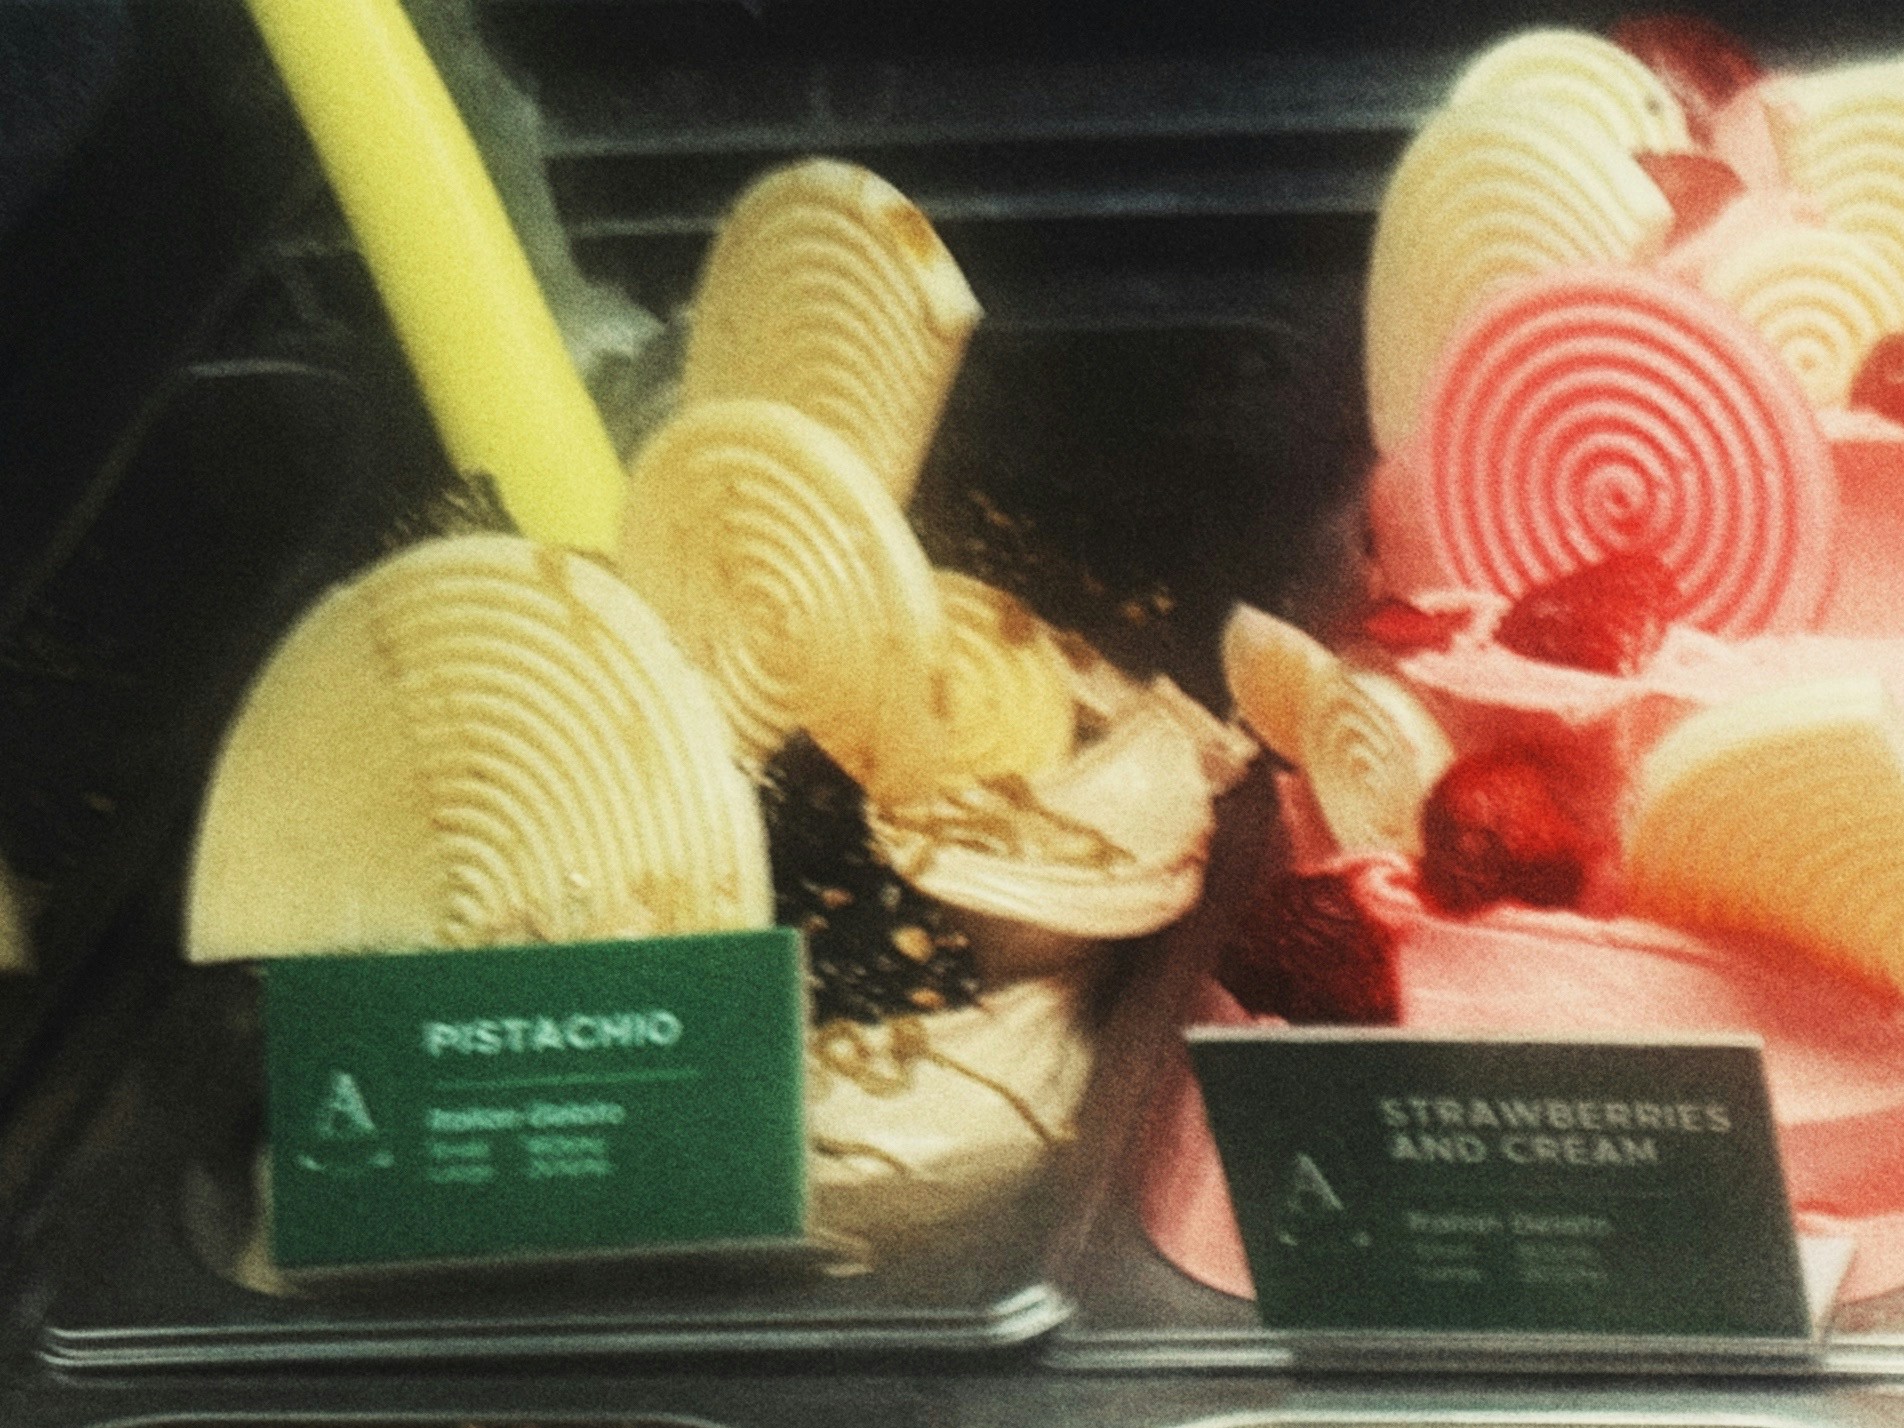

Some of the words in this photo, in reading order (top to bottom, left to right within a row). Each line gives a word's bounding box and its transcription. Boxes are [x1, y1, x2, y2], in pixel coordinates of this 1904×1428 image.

[422, 1009, 683, 1057] PISTACHIO
[1380, 1098, 1732, 1133] STRAWBERRIES
[1392, 1133, 1487, 1163] AND
[1500, 1134, 1659, 1167] CREAM
